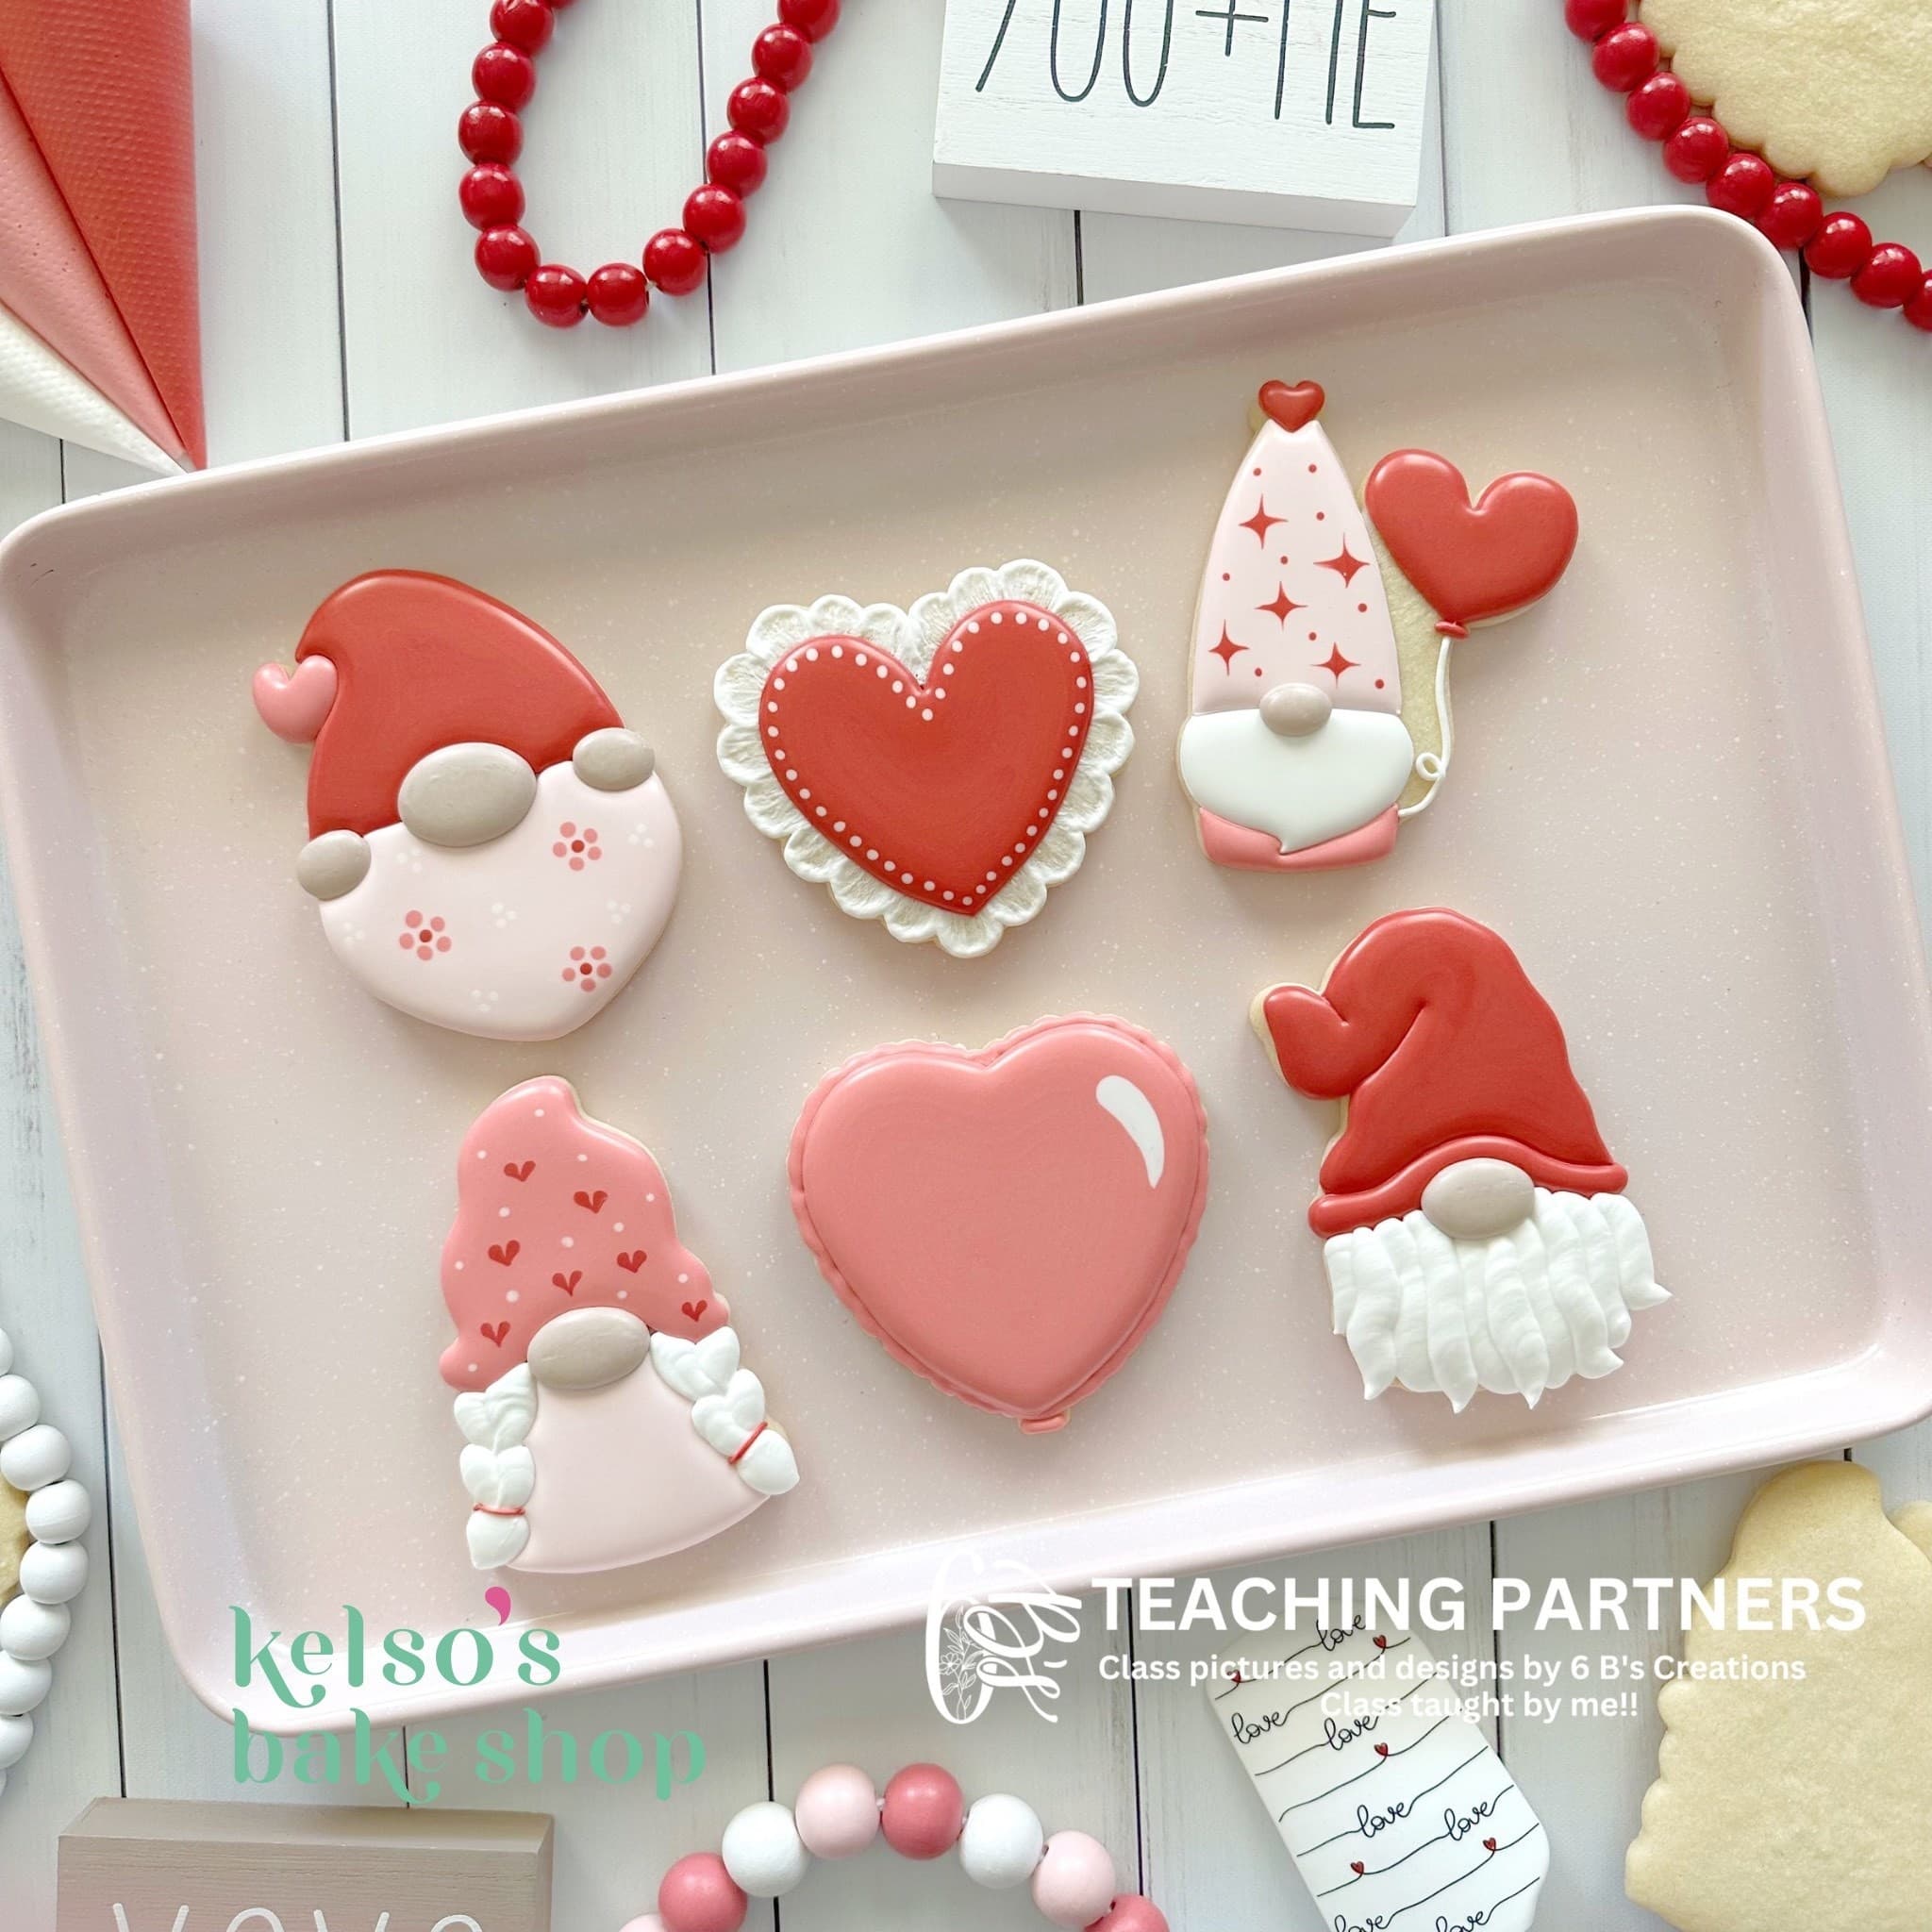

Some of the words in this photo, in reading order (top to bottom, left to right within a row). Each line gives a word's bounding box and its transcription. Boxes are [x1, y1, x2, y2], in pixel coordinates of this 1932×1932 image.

[1230, 1711, 1285, 1744] love
[1323, 1715, 1378, 1751] love
[1356, 1801, 1411, 1838] love
[1443, 1801, 1495, 1841] love
